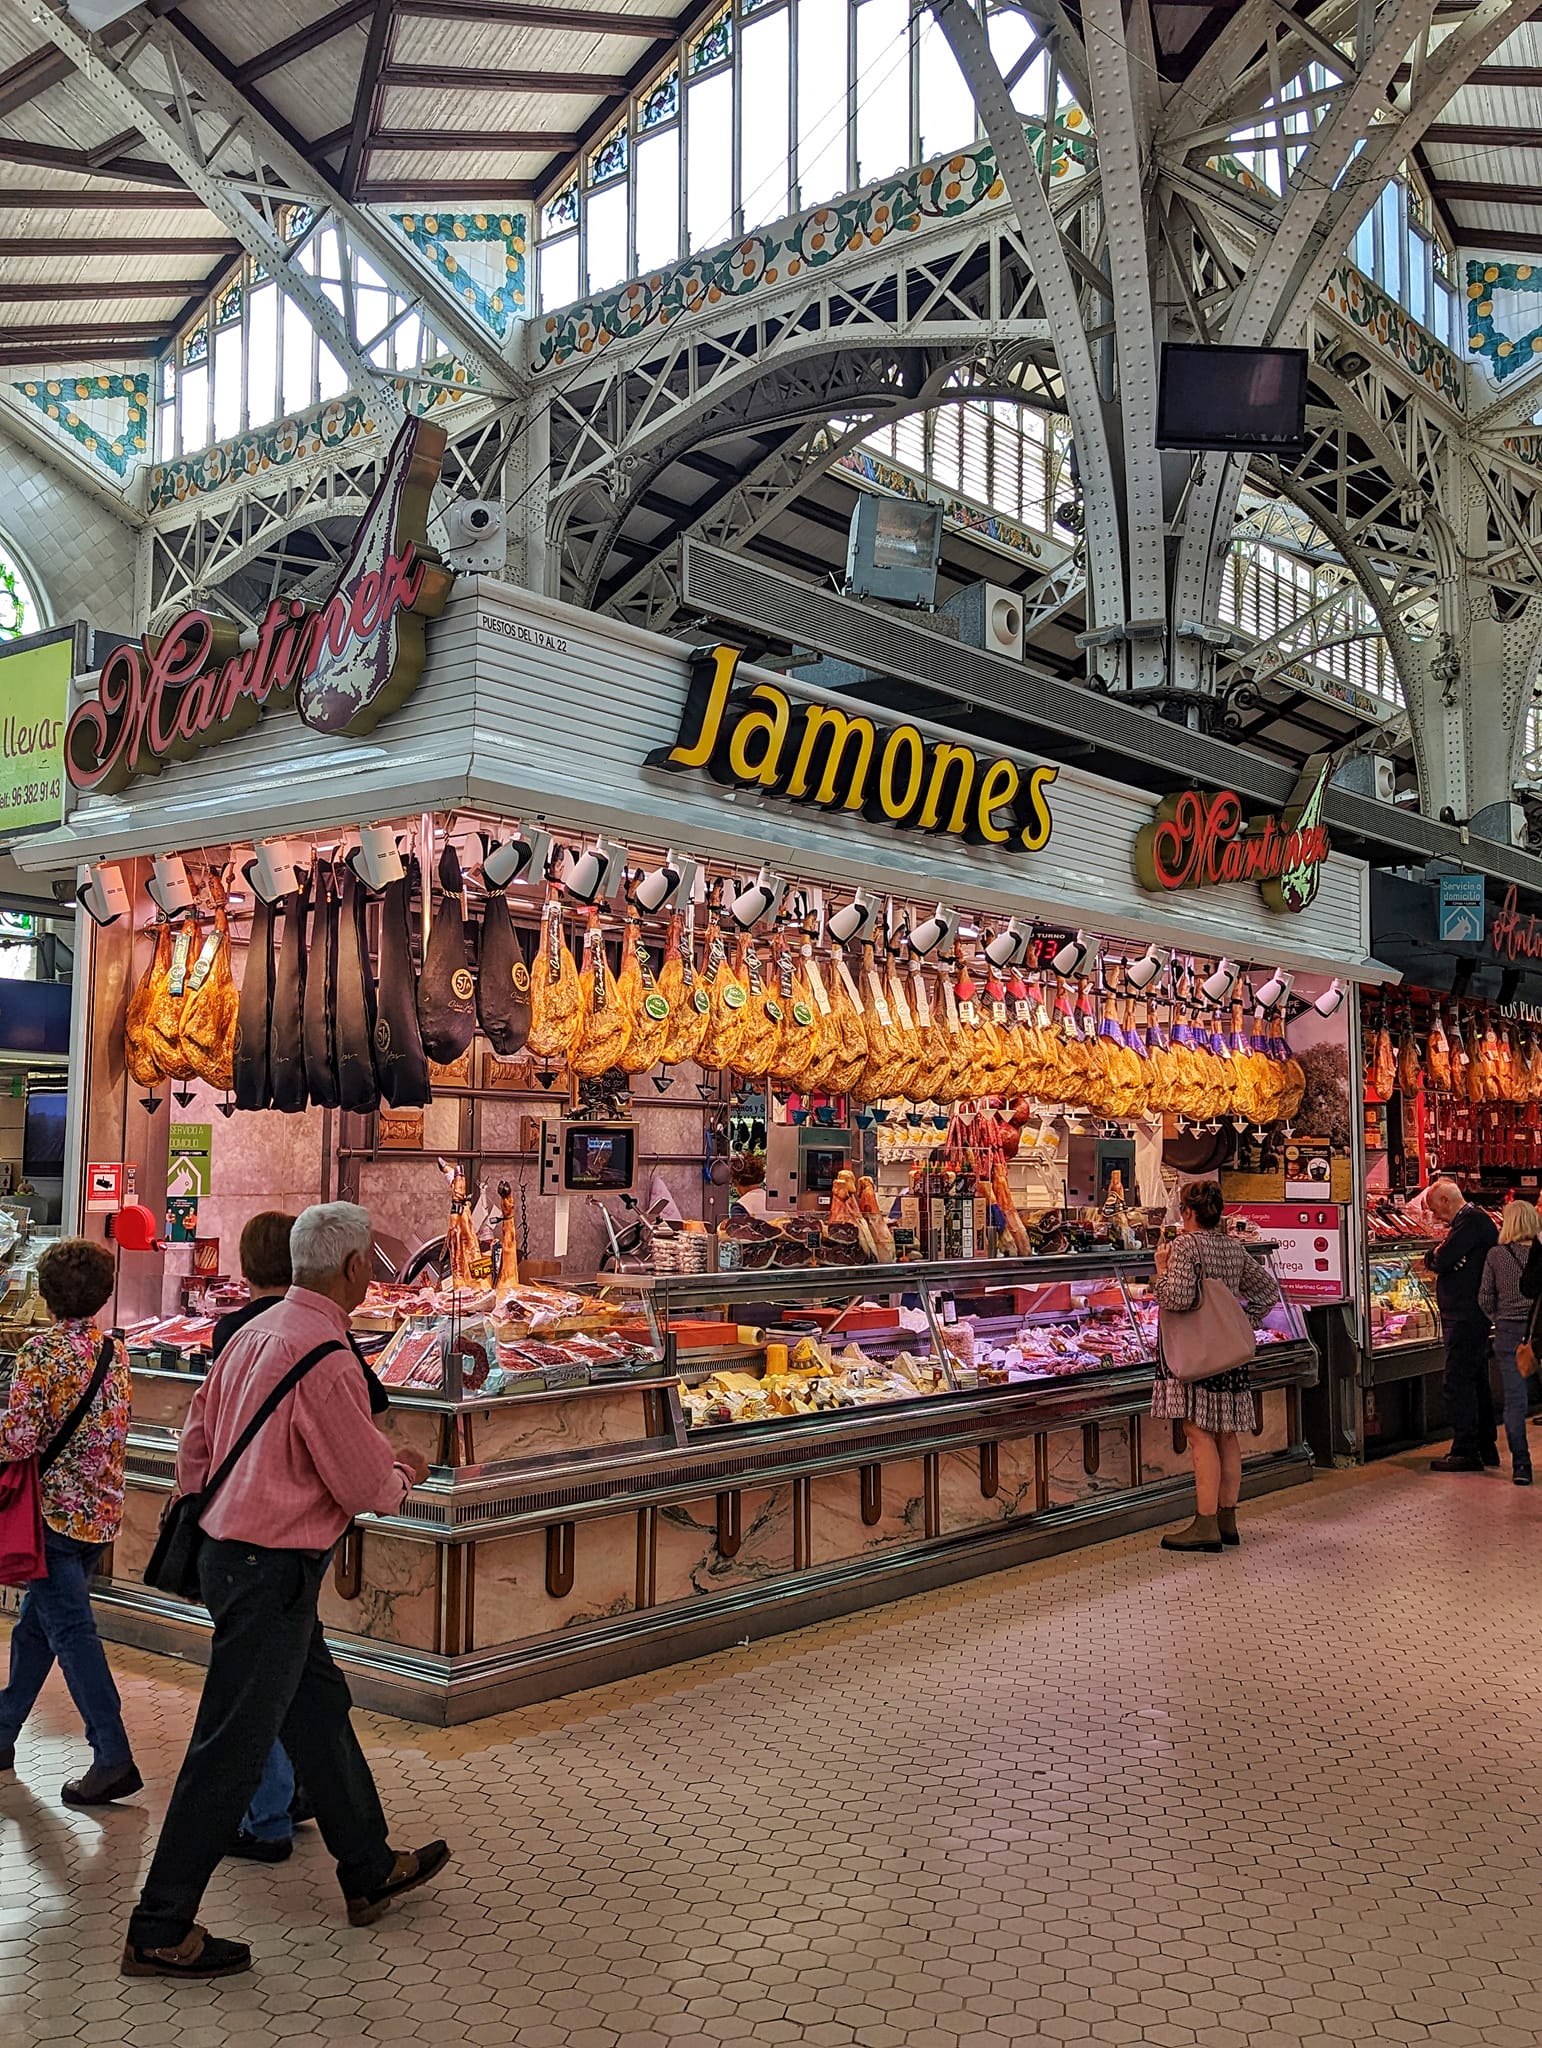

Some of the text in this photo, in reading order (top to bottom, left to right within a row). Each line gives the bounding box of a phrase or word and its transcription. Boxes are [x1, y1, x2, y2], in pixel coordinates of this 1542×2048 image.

[482, 615, 567, 653] PUESTOS DEL 19 AL 22
[3, 715, 63, 758] llevar
[664, 644, 1060, 852] Jamones
[12, 786, 22, 807] 96
[23, 782, 39, 805] 382
[40, 781, 49, 802] 91
[50, 777, 60, 800] 43
[1154, 790, 1331, 890] Martinez
[1443, 891, 1481, 901] domicilio
